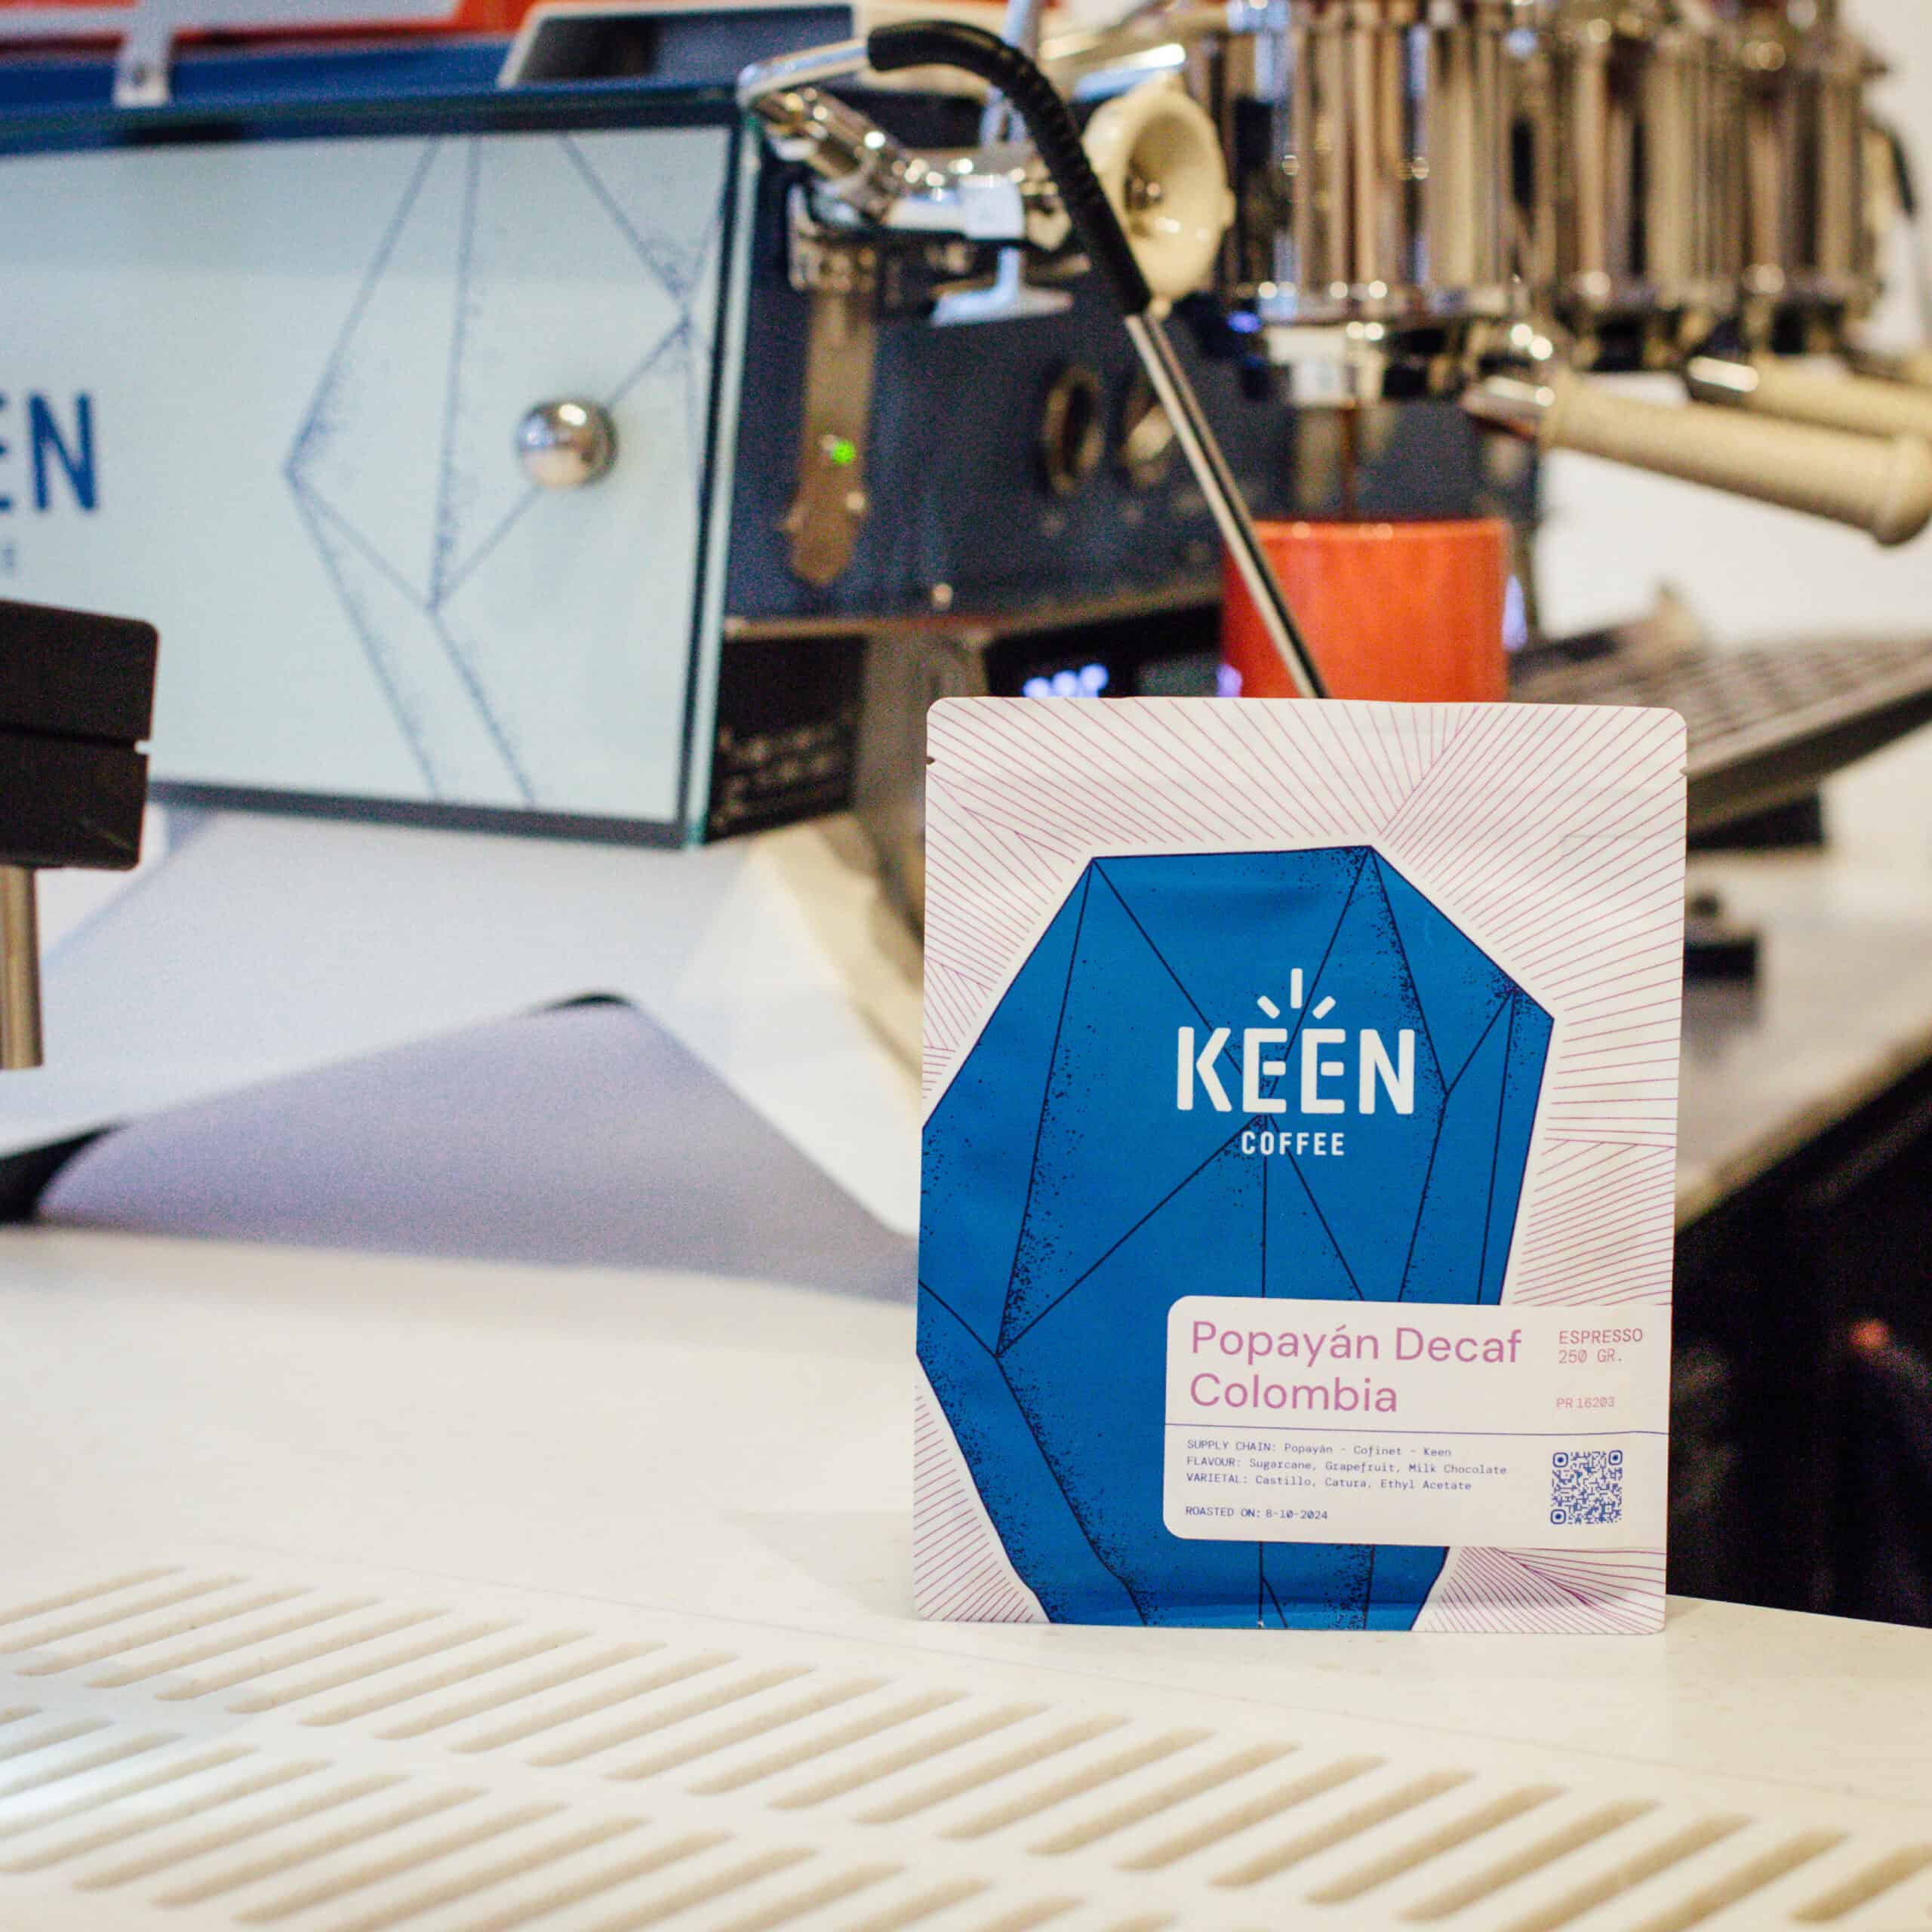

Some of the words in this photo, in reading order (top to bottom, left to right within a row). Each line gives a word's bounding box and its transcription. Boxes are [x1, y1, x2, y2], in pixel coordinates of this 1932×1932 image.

[1177, 1026, 1416, 1115] KEEN
[1241, 1131, 1346, 1156] COFFEE
[1192, 1321, 1380, 1367] Popayán
[1395, 1327, 1523, 1364] Decaf
[1558, 1327, 1644, 1345] ESPRESSO
[1558, 1349, 1588, 1364] 250
[1596, 1348, 1623, 1363] GR.
[1189, 1373, 1398, 1413] Colombia
[1187, 1439, 1229, 1450] SUPPLY
[1235, 1441, 1276, 1452] CHAIN:
[1284, 1442, 1333, 1456] Popayán
[1353, 1445, 1401, 1457] Cofinet
[1423, 1447, 1451, 1457] Keen
[1186, 1456, 1241, 1467] FLAVOUR:
[1249, 1458, 1316, 1471] Sugarcane,
[1324, 1461, 1400, 1473] Grapefruit,
[1408, 1463, 1436, 1473] Milk
[1443, 1464, 1507, 1475] Chocolate
[1186, 1472, 1247, 1484] VARIETAL:
[1255, 1475, 1316, 1487] Castillo,
[1324, 1477, 1371, 1489] Catura,
[1380, 1478, 1415, 1491] Ethyl
[1422, 1480, 1472, 1491] Acetate
[1186, 1506, 1235, 1517] ROASTED
[1240, 1508, 1260, 1518] ON:
[1266, 1509, 1328, 1520] 8-10-2024
